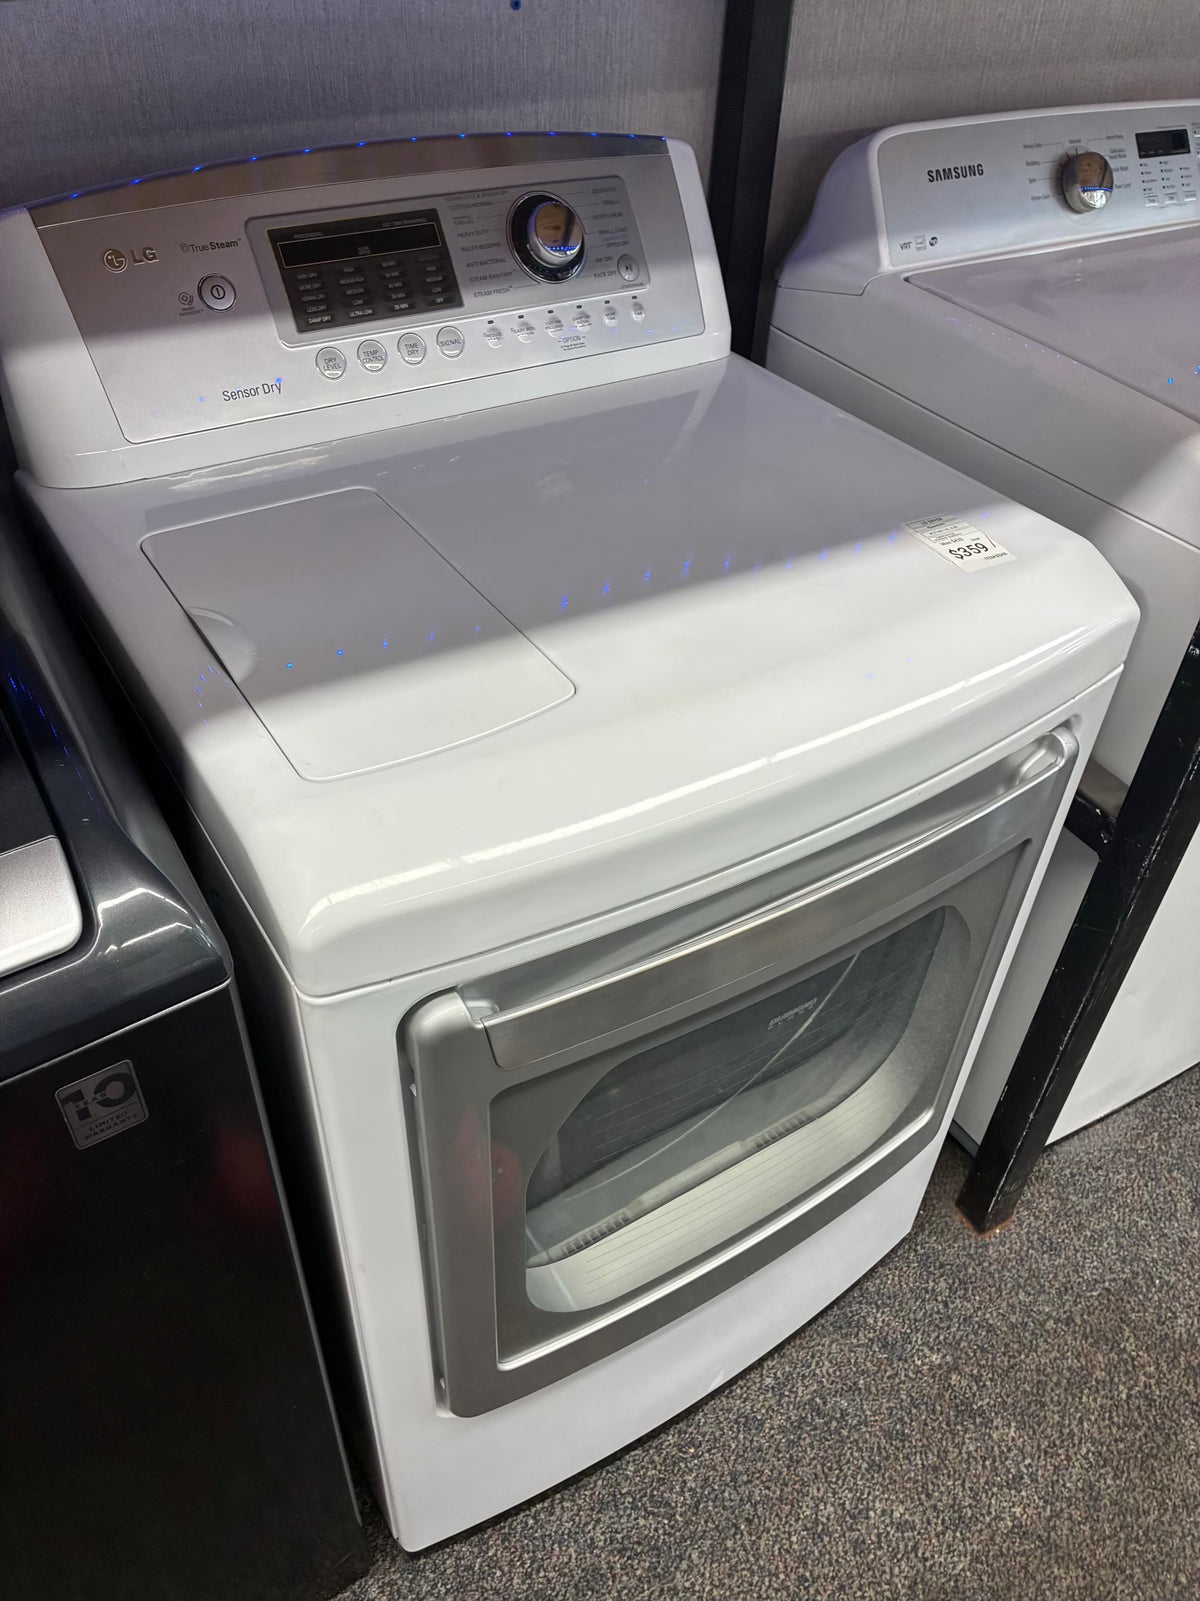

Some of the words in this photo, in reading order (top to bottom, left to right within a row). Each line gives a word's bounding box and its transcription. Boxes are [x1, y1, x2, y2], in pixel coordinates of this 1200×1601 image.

[927, 163, 984, 183] SAMSUNG
[132, 246, 159, 266] LG
[473, 290, 492, 298] STEAM
[440, 340, 462, 348] SIGNAL
[562, 336, 582, 344] OPTION
[362, 356, 384, 364] CONTROL
[407, 348, 420, 356] DRY
[324, 357, 336, 365] DRY
[222, 386, 260, 402] Sensor
[262, 382, 282, 394] Dry
[948, 542, 989, 560] $359
[60, 1072, 136, 1121] 10
[74, 1092, 107, 1108] YEAR
[84, 1113, 138, 1140] WARRANTY
[89, 1110, 128, 1131] LIMITED
